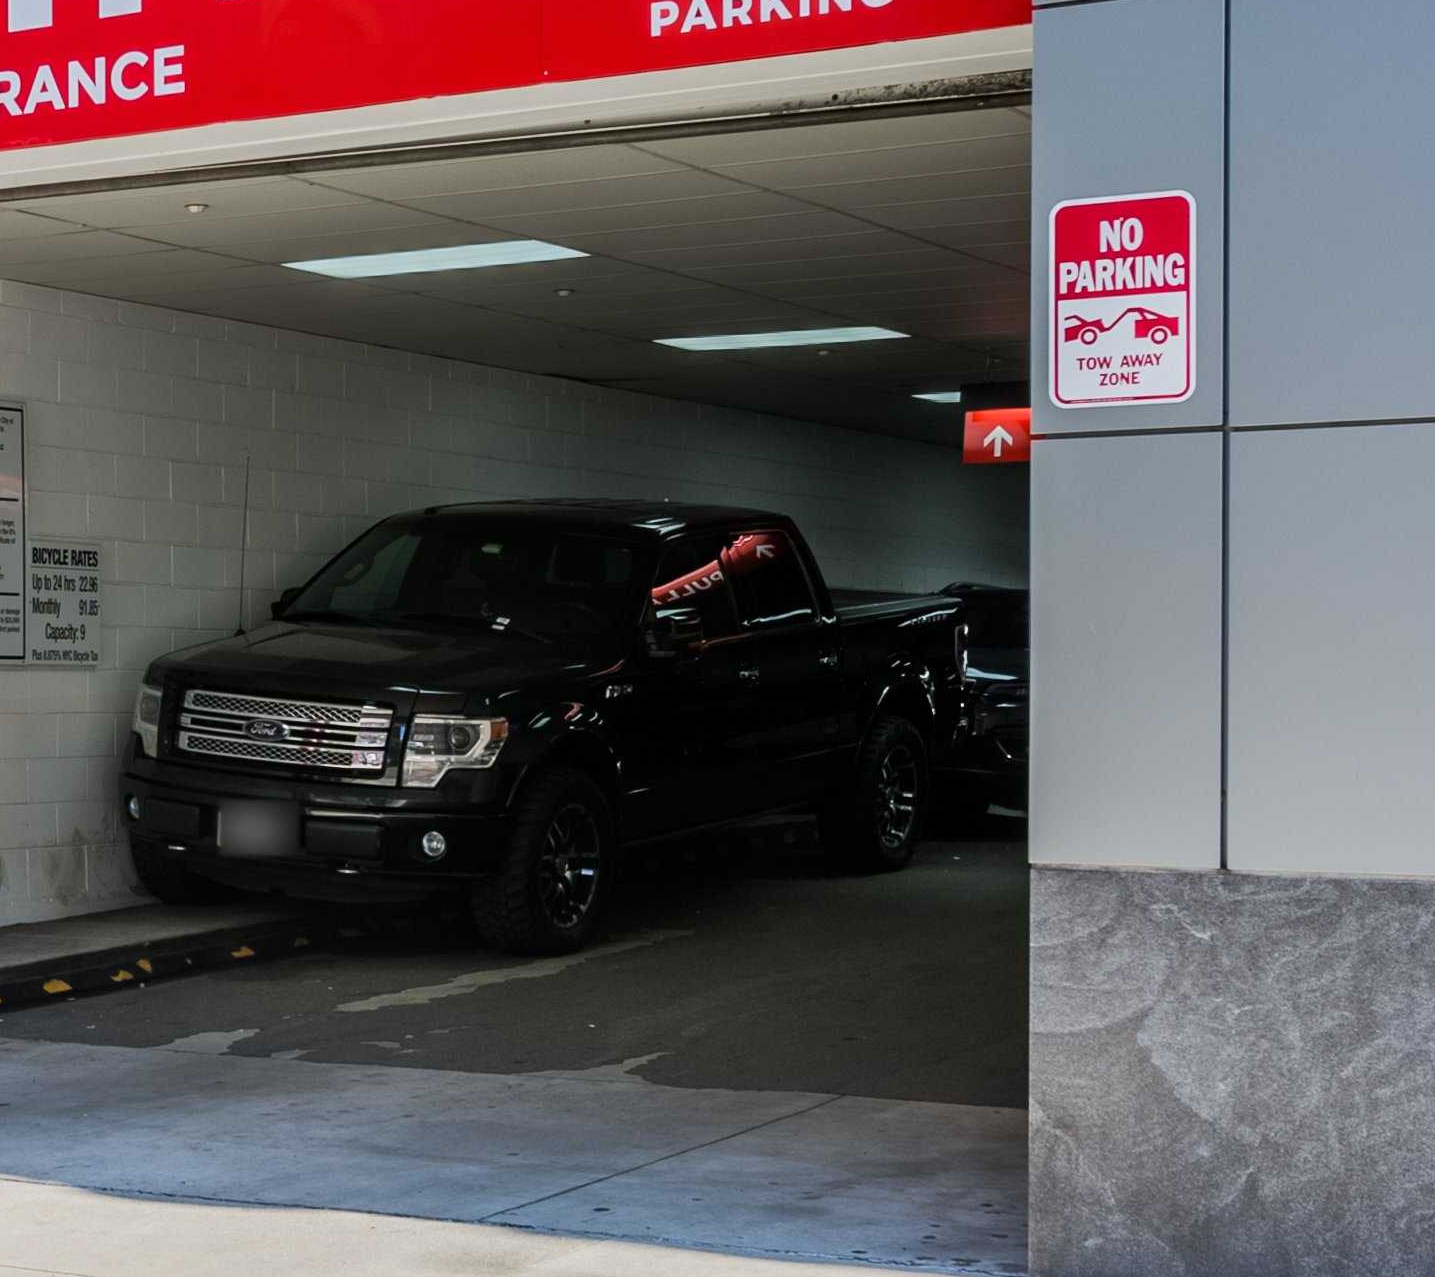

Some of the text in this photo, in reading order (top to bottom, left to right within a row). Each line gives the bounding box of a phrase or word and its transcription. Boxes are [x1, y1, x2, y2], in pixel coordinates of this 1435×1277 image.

[1099, 217, 1144, 253] NO
[1059, 252, 1185, 294] PARKING
[1076, 353, 1164, 371] TOW AWAY
[1099, 371, 1141, 387] ZONE
[32, 547, 98, 567] BICYCLE RATES
[32, 573, 42, 594] Up
[44, 574, 51, 590] to
[53, 574, 62, 591] 24
[64, 575, 76, 592] hrs
[32, 597, 61, 619] Monthly
[45, 623, 79, 644] Capacity:
